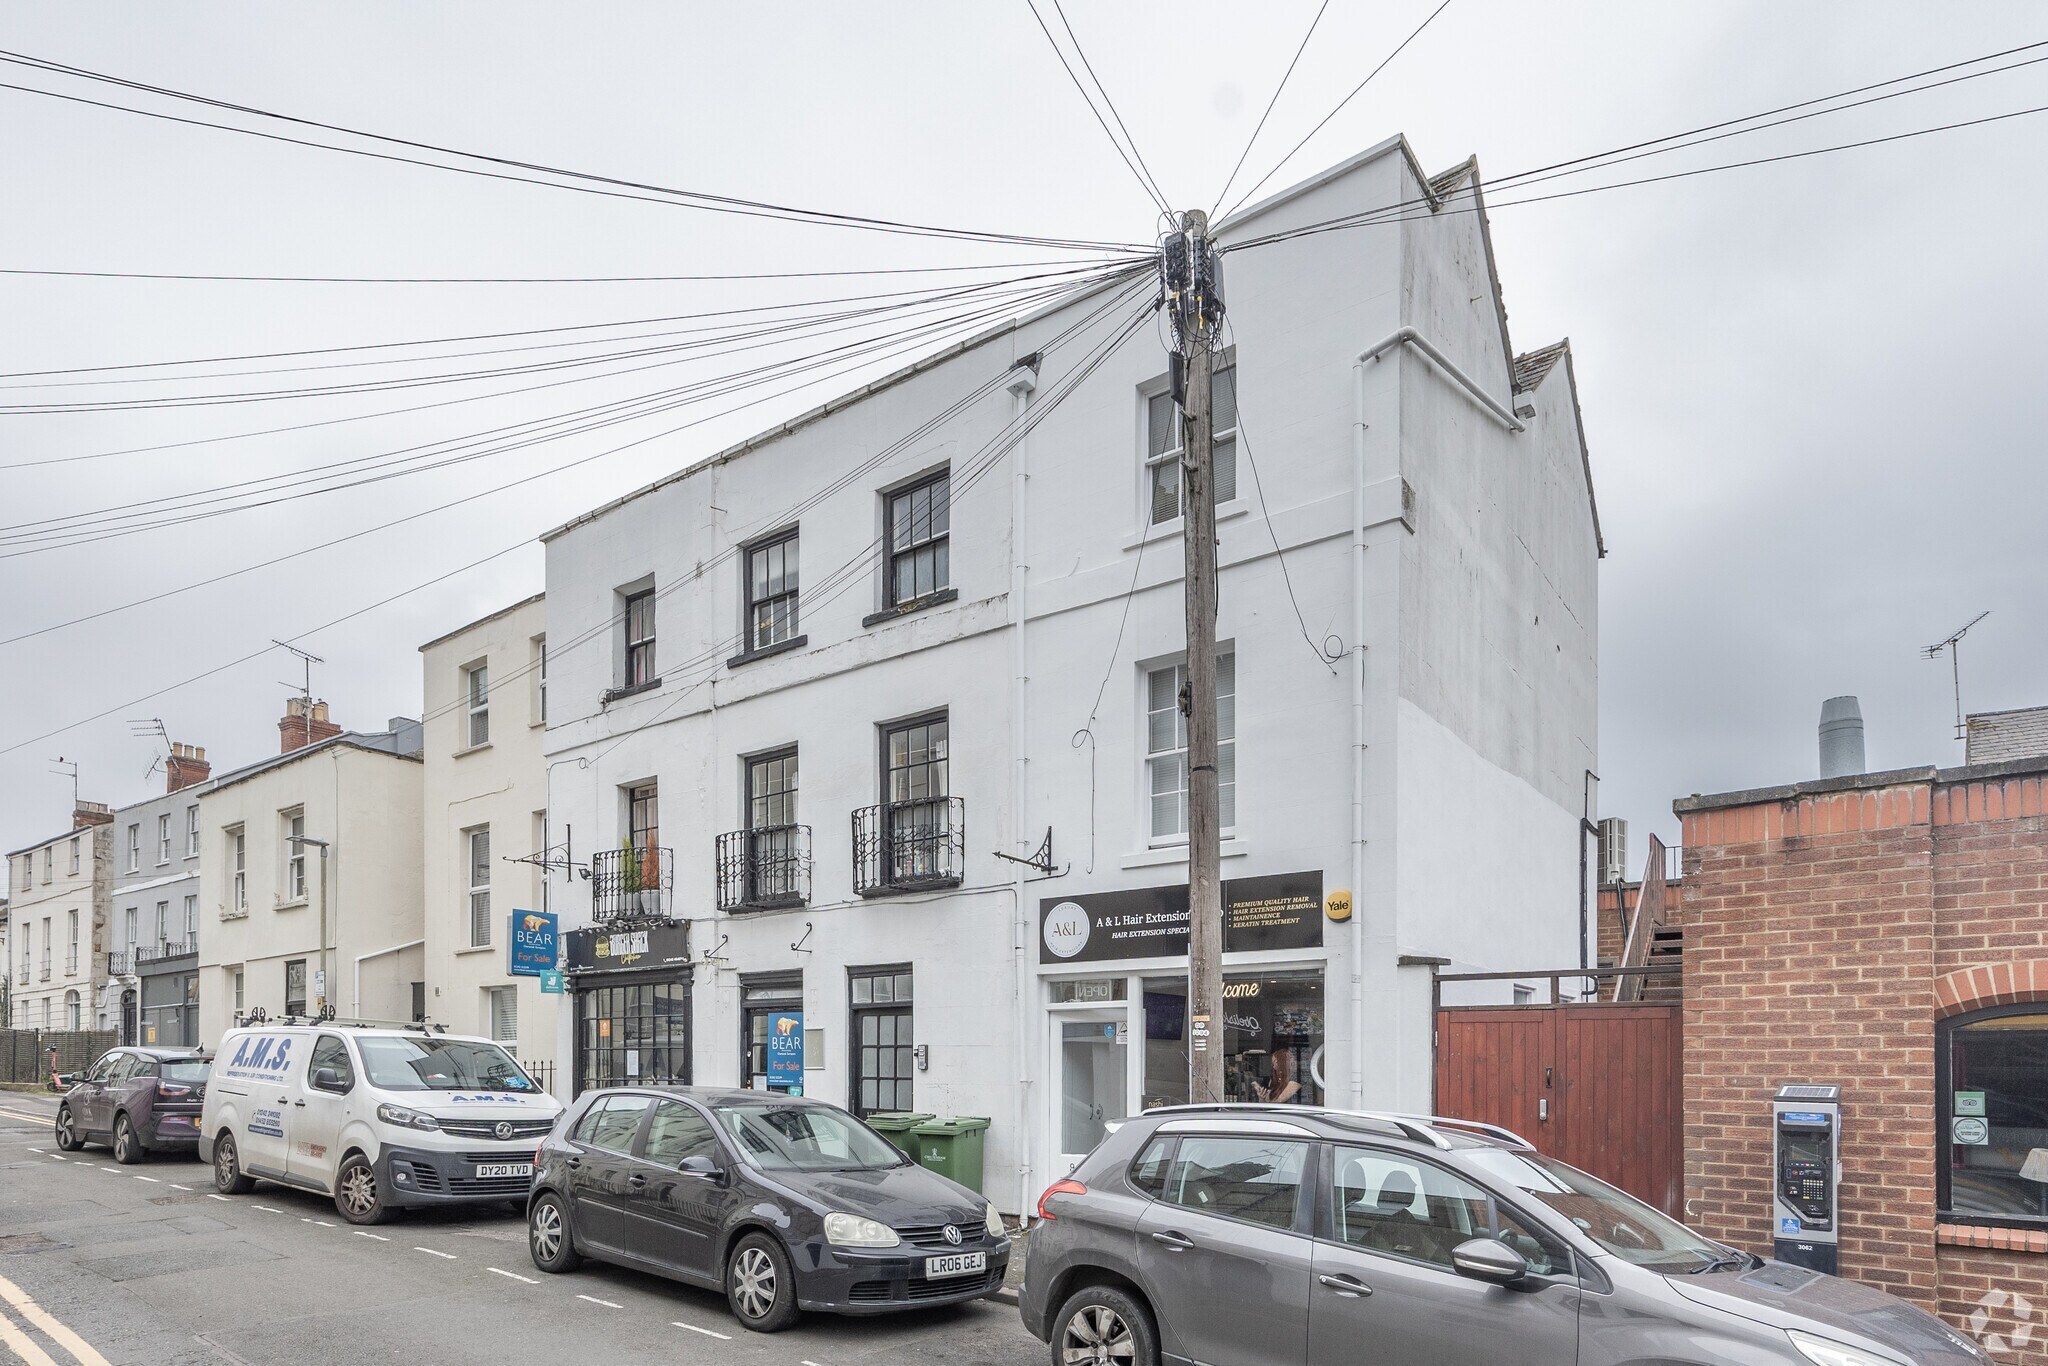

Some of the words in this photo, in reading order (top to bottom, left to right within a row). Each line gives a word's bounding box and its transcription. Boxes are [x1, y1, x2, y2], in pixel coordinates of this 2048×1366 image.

[1233, 900, 1264, 908] PREMIUM
[1264, 898, 1292, 906] QUALITY
[1250, 906, 1285, 914] EXTENSION
[1287, 902, 1317, 910] REMOVAL
[1328, 901, 1348, 911] Yale
[1096, 918, 1103, 927] A
[1105, 917, 1112, 926] &
[1115, 916, 1120, 926] L
[1123, 914, 1143, 925] Hair
[1261, 918, 1300, 926] TREATMENT
[1052, 921, 1082, 937] A&L
[1129, 930, 1166, 938] EXTENSION
[518, 931, 552, 945] BEAR
[518, 952, 532, 961] For
[534, 953, 550, 962] Sale
[1222, 982, 1259, 998] lcome
[772, 1037, 801, 1049] BEAR
[230, 1037, 291, 1071] A.M.S.
[773, 1061, 784, 1070] For
[786, 1061, 799, 1070] Sale
[481, 1166, 507, 1175] DY20
[510, 1165, 528, 1174] TVD
[932, 1256, 961, 1273] LR06
[964, 1255, 982, 1270] GEJ
